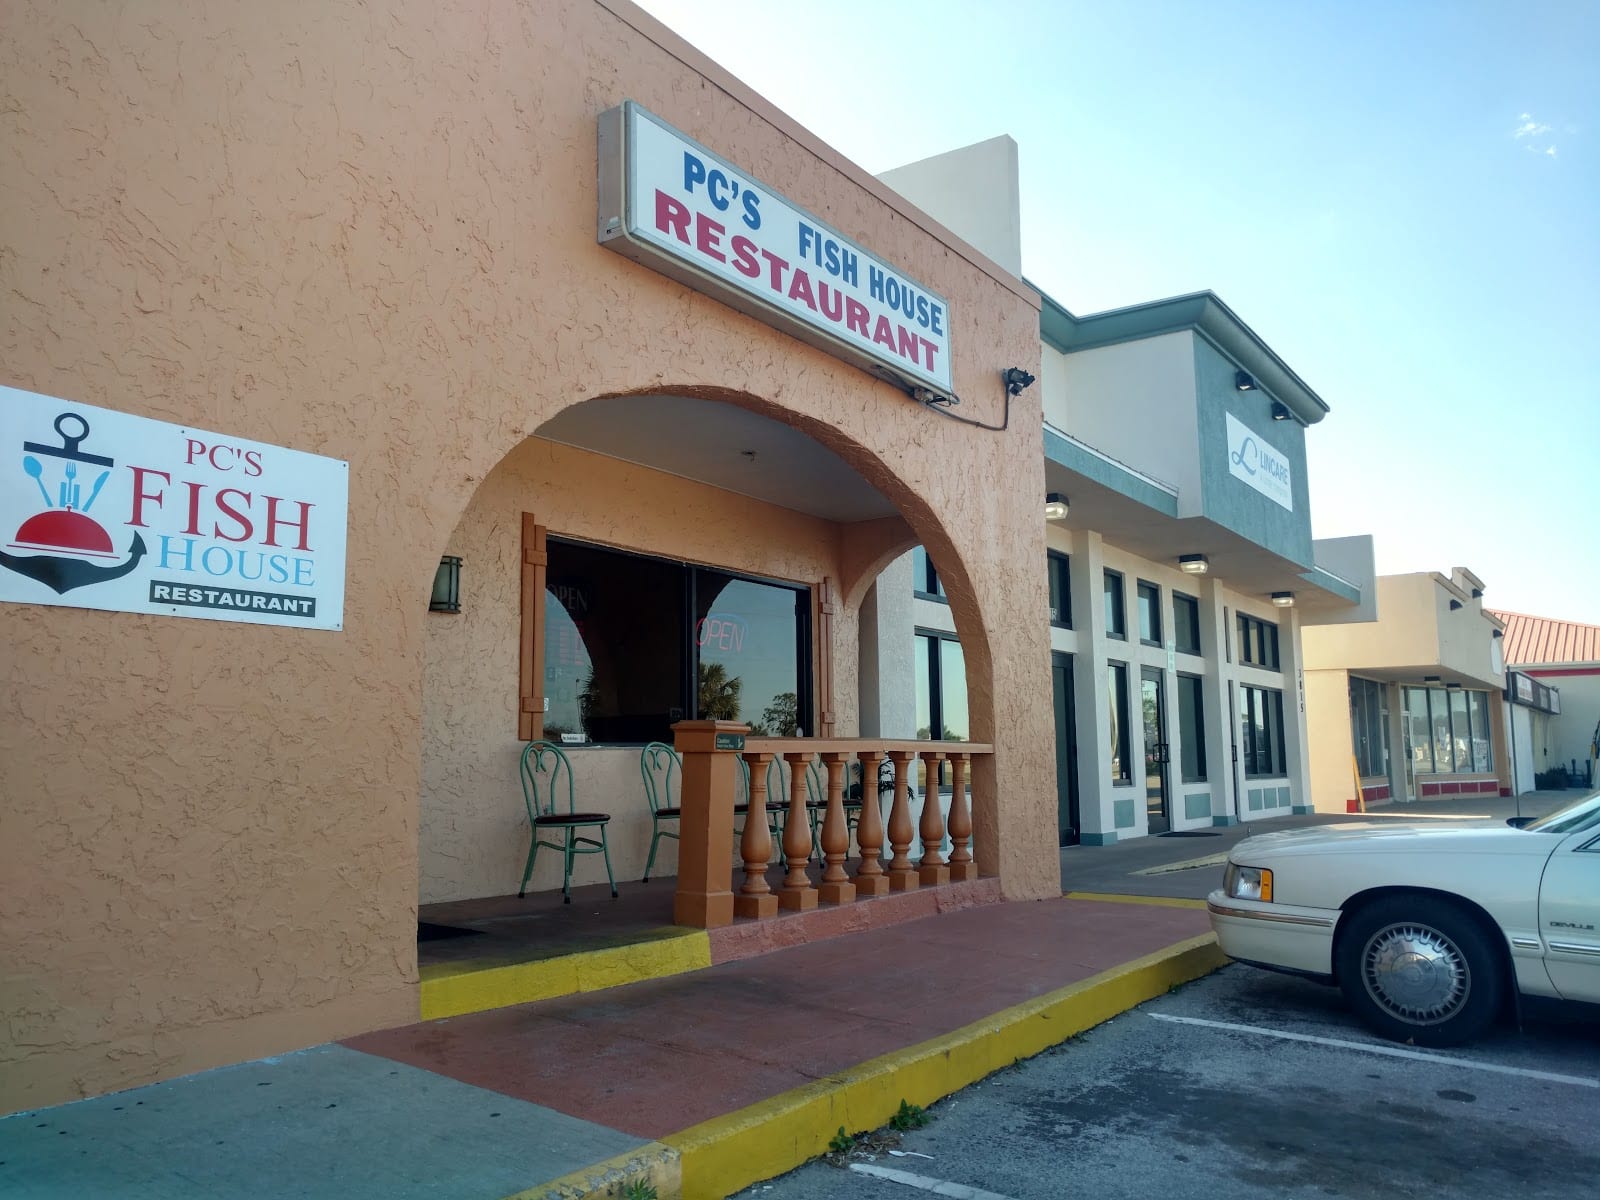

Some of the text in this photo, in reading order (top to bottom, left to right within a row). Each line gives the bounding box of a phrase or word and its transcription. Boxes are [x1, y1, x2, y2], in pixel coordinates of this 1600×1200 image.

[684, 151, 943, 337] PC'S FISH HOUSE
[655, 188, 939, 373] RESTAURANT
[184, 438, 263, 477] PC'S
[124, 465, 316, 551] FISH
[156, 535, 315, 586] HOUSE
[154, 585, 312, 613] RESTAURANT
[696, 618, 744, 652] OPEN
[1550, 921, 1595, 931] DEVILLE
